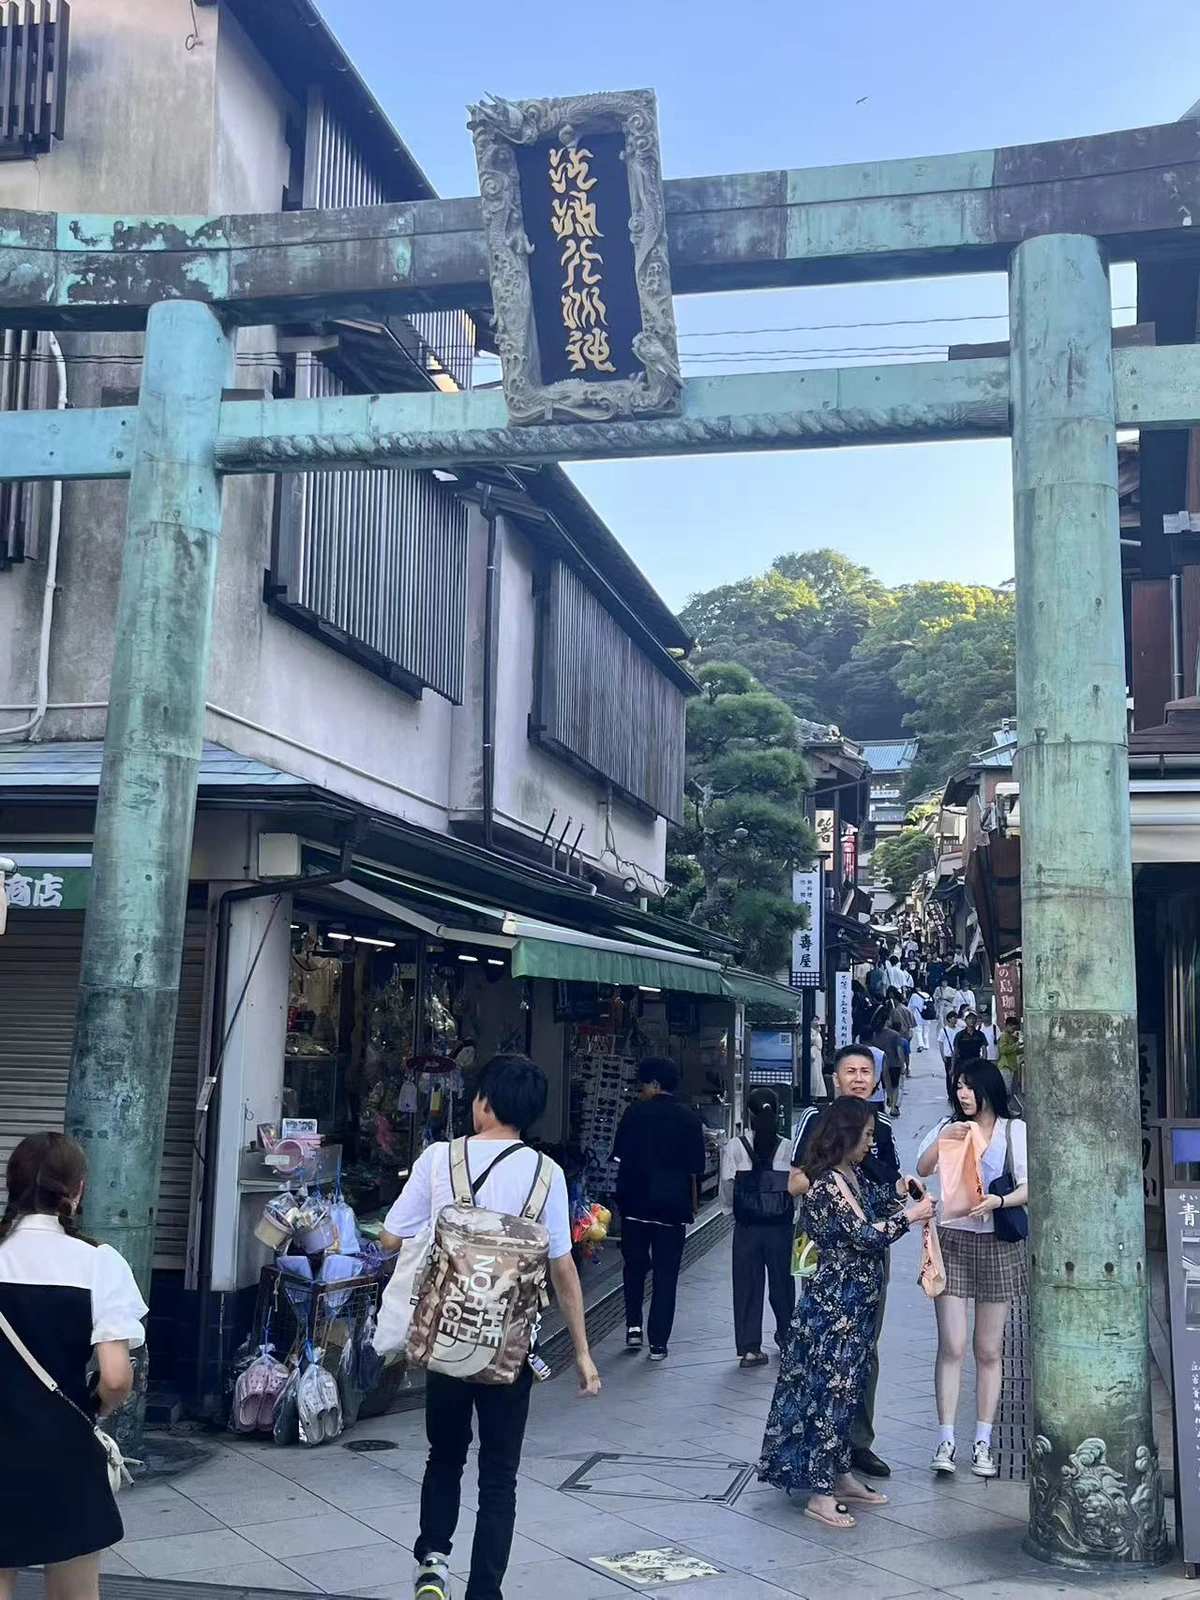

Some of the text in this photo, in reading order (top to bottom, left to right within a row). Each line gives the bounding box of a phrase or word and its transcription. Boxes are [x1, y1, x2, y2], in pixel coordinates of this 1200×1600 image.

[4, 872, 64, 907] 商店
[1177, 1202, 1200, 1227] 青
[438, 1272, 470, 1337] FACE
[457, 1254, 496, 1343] NORTH
[478, 1297, 508, 1347] THE
